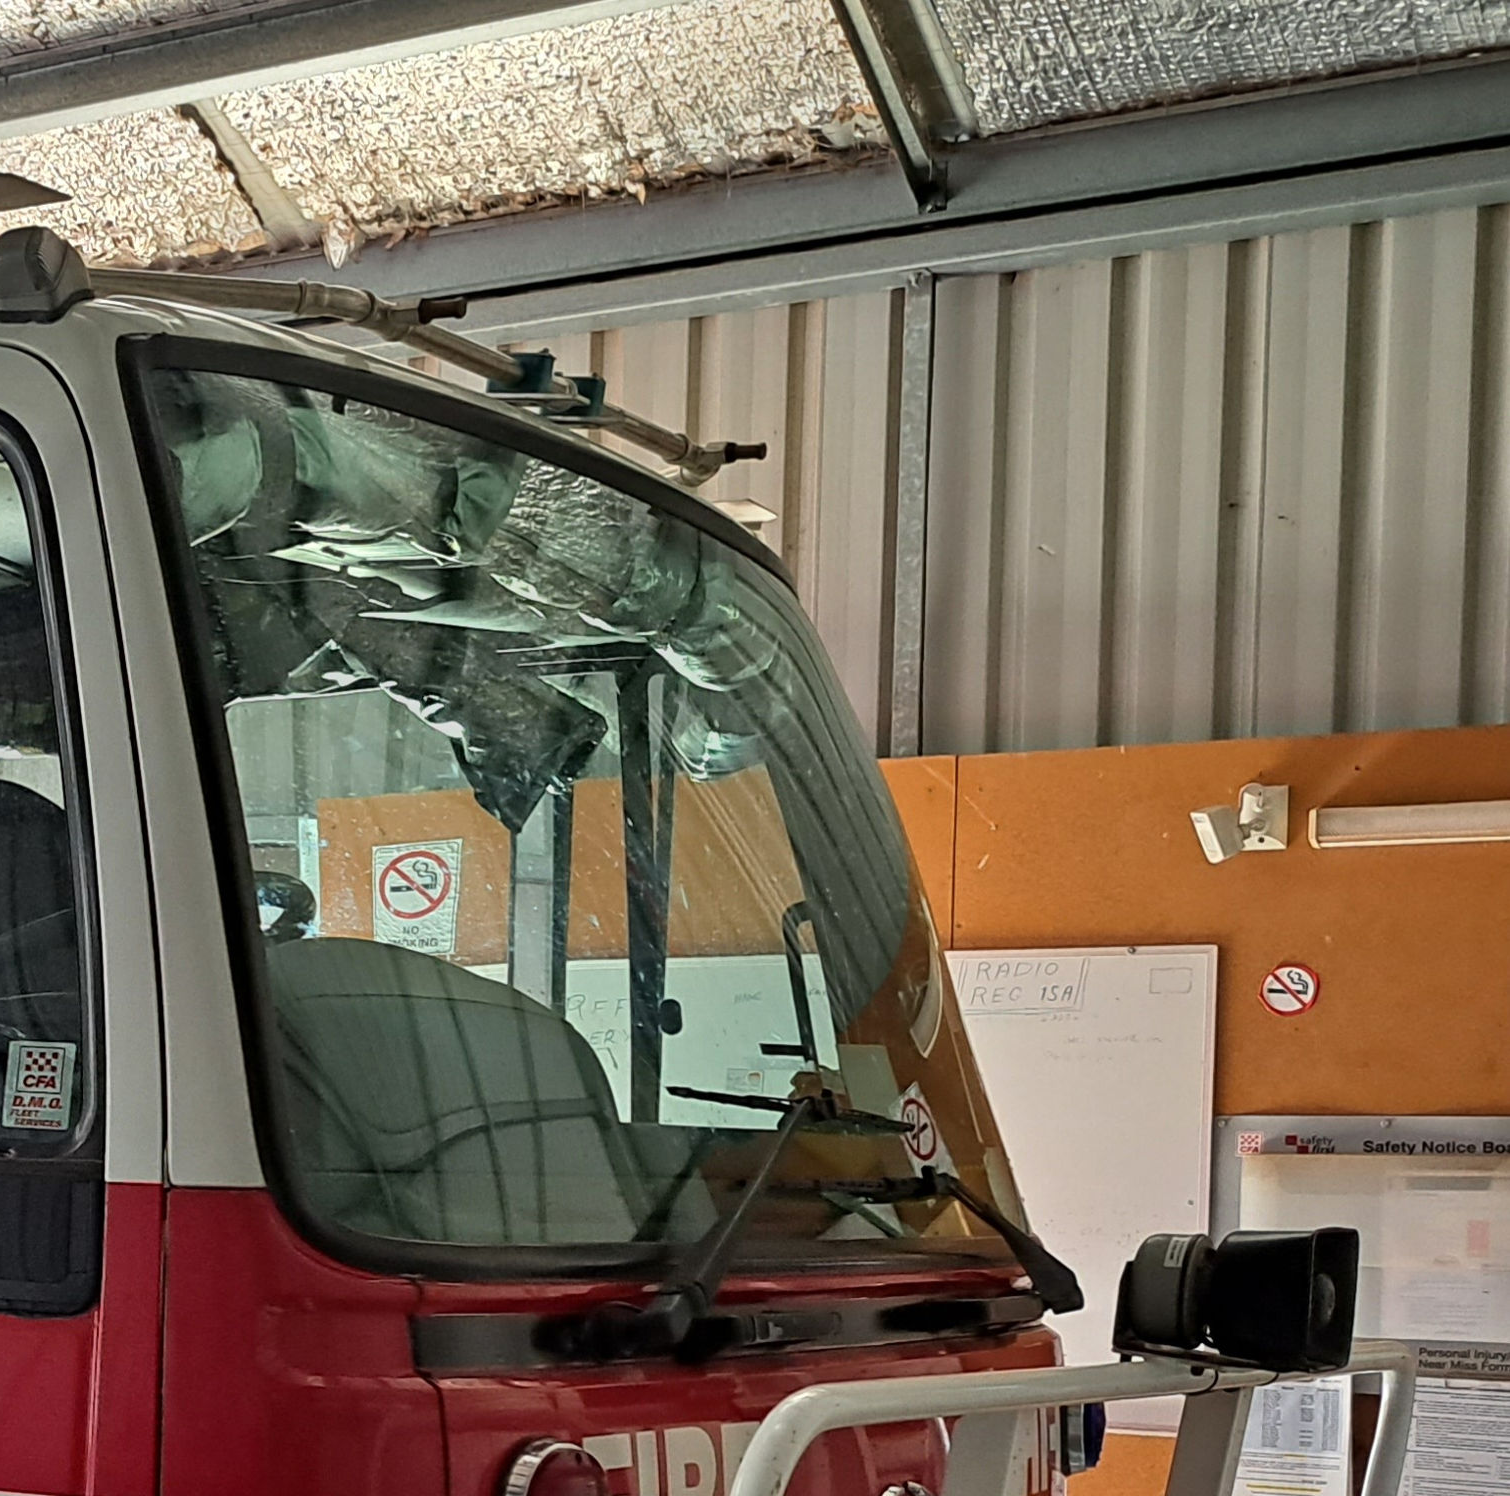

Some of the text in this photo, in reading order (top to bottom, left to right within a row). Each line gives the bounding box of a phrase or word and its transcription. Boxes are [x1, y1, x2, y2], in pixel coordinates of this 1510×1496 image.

[403, 925, 420, 936] NO
[387, 936, 440, 949] OKING
[975, 962, 1060, 982] RADIO
[23, 1074, 57, 1089] CFA
[13, 1118, 62, 1128] SERVICES
[1300, 1134, 1334, 1146] safety
[1240, 1146, 1259, 1154] CFA
[1363, 1140, 1416, 1156] Safety
[1421, 1140, 1477, 1154] Notice
[1419, 1346, 1471, 1359] Personal
[1419, 1359, 1446, 1369] Near
[1450, 1360, 1478, 1370] Miss
